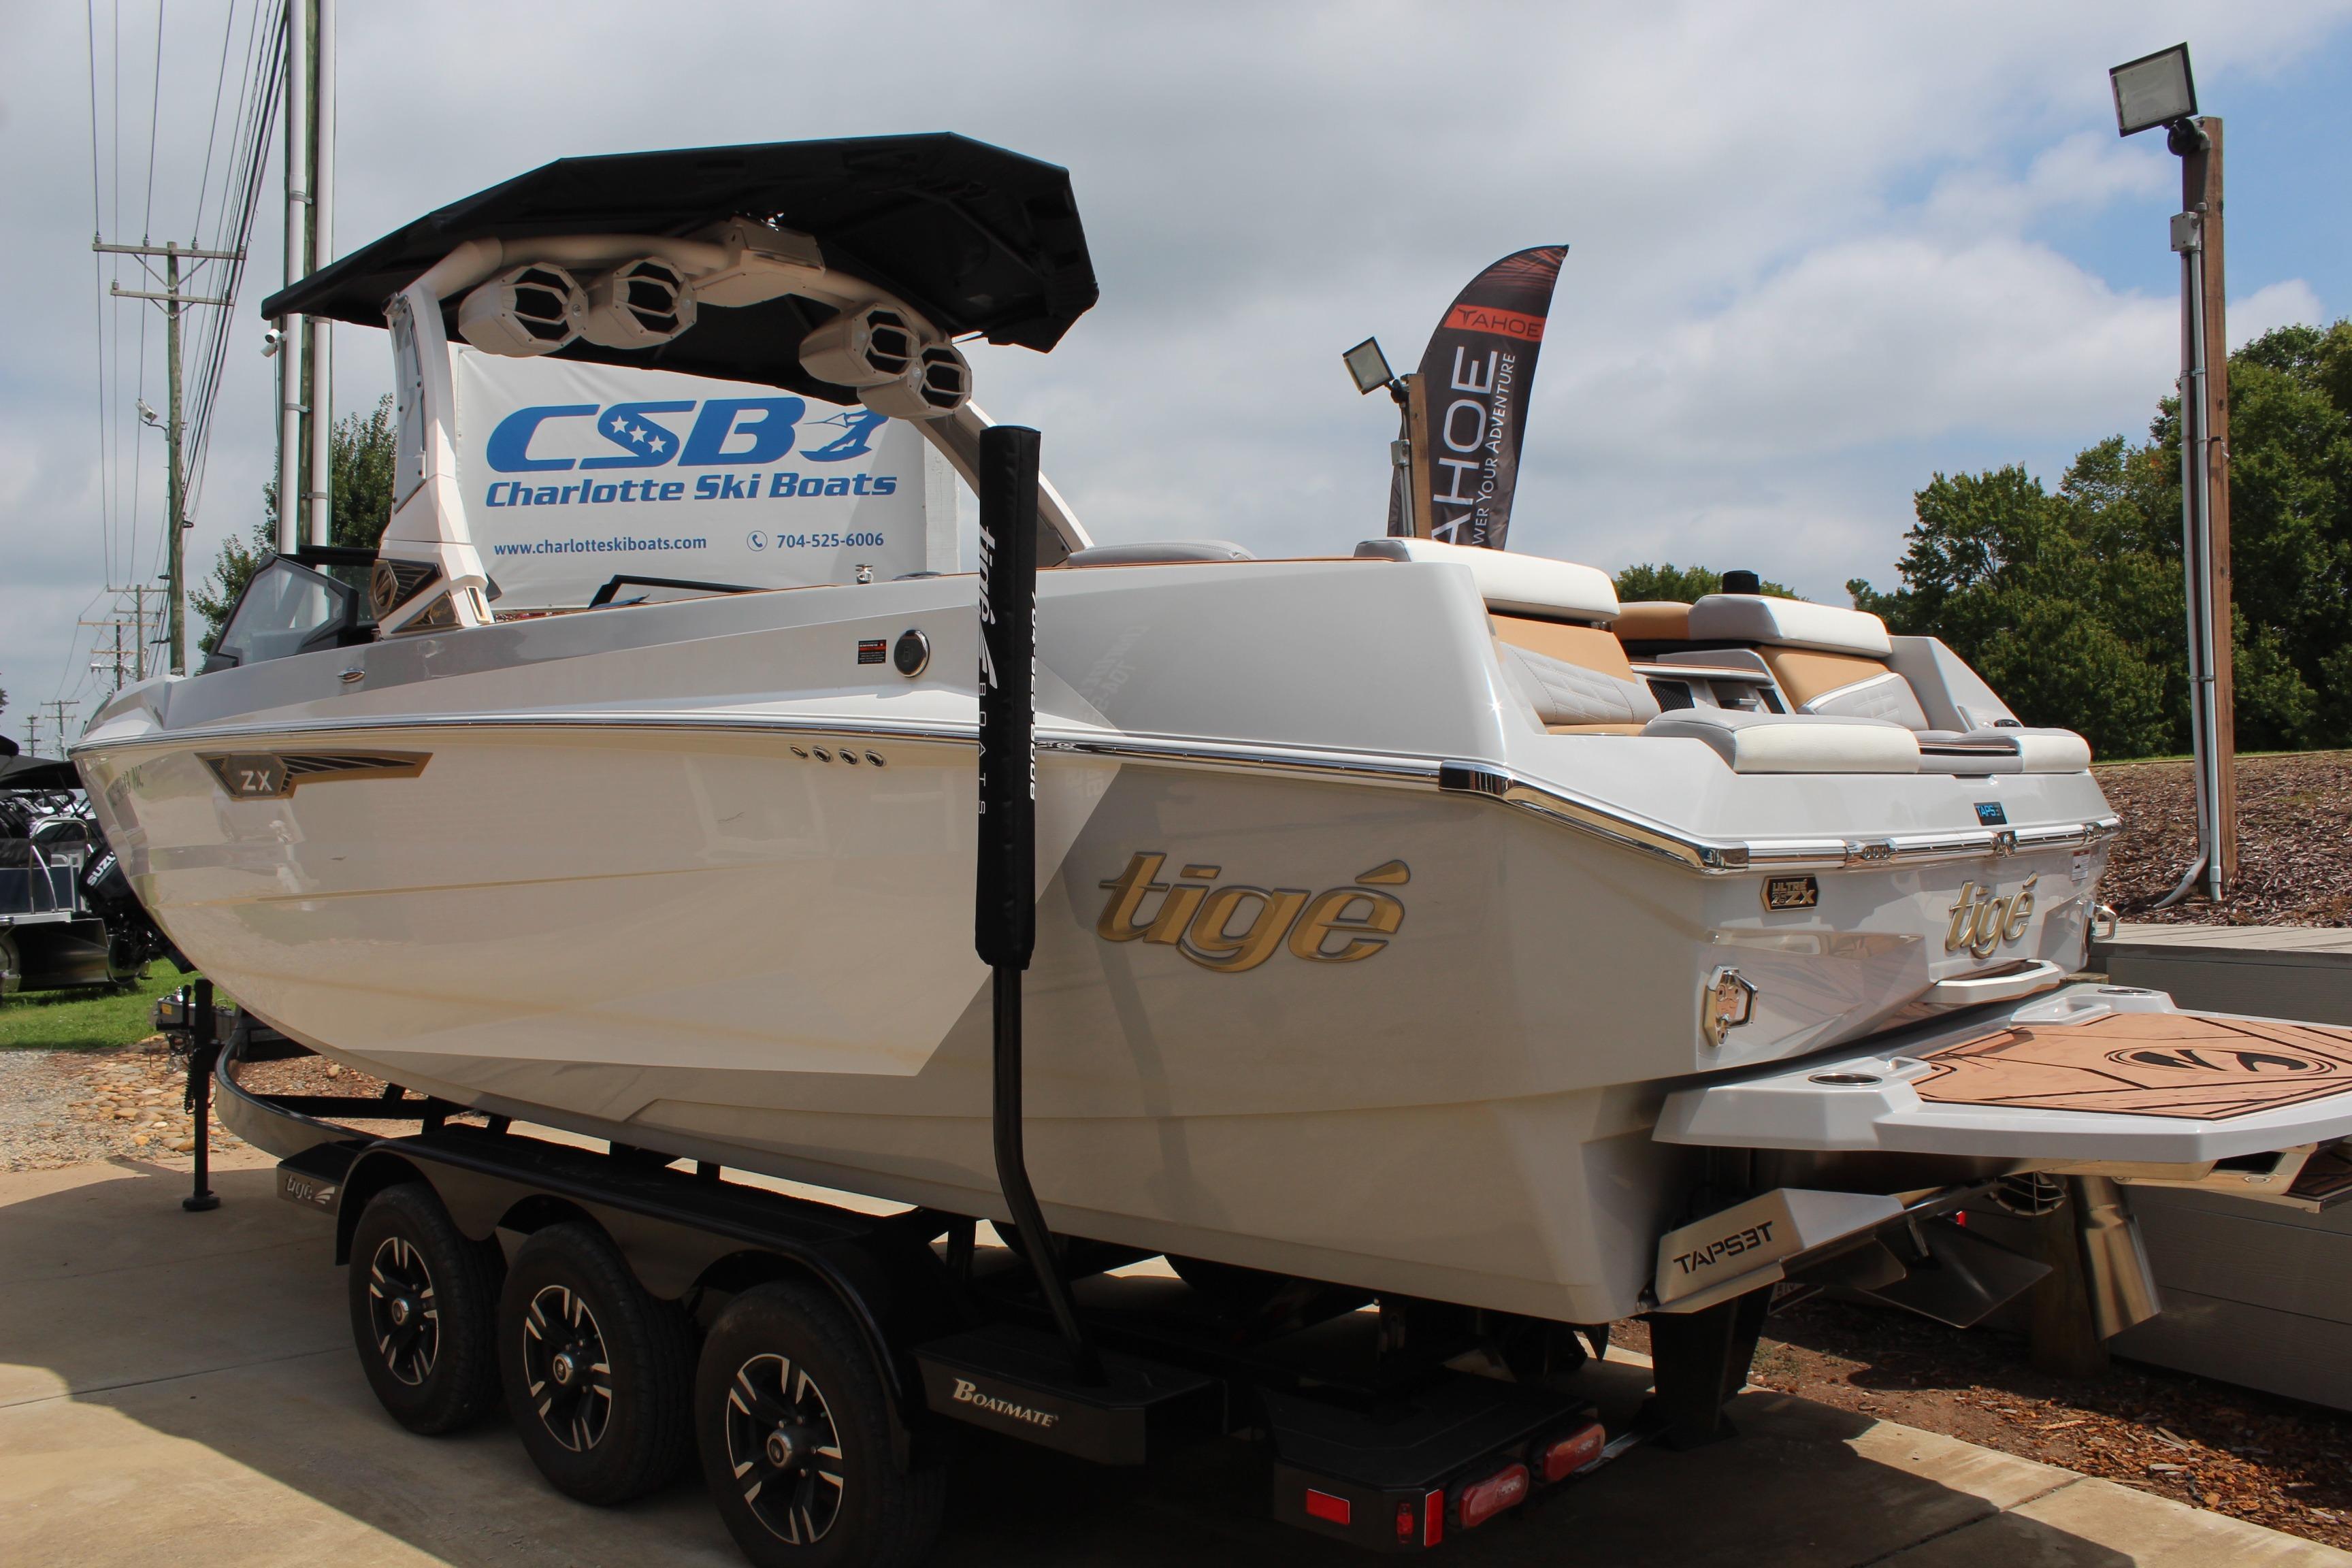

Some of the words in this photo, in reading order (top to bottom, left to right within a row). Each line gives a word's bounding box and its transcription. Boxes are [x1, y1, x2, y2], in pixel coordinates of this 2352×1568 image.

[1458, 308, 1541, 338] TAHOE
[1485, 353, 1516, 454] ADVENTURE
[486, 397, 806, 473] CSB
[1431, 346, 1498, 545] AHOE
[485, 478, 685, 507] Charlotte
[693, 472, 762, 500] Ski
[768, 472, 898, 498] Boats
[1475, 457, 1498, 503] YOUR
[494, 535, 706, 555] www.charlotteskiboats.com
[777, 532, 884, 549] 704-525-6006
[1472, 508, 1490, 544] WER
[240, 770, 273, 792] ZX
[86, 851, 116, 886] SUZU
[1095, 851, 1411, 973] tigé
[1945, 871, 2039, 959] tigé
[1672, 1220, 1774, 1275] TAPS3T
